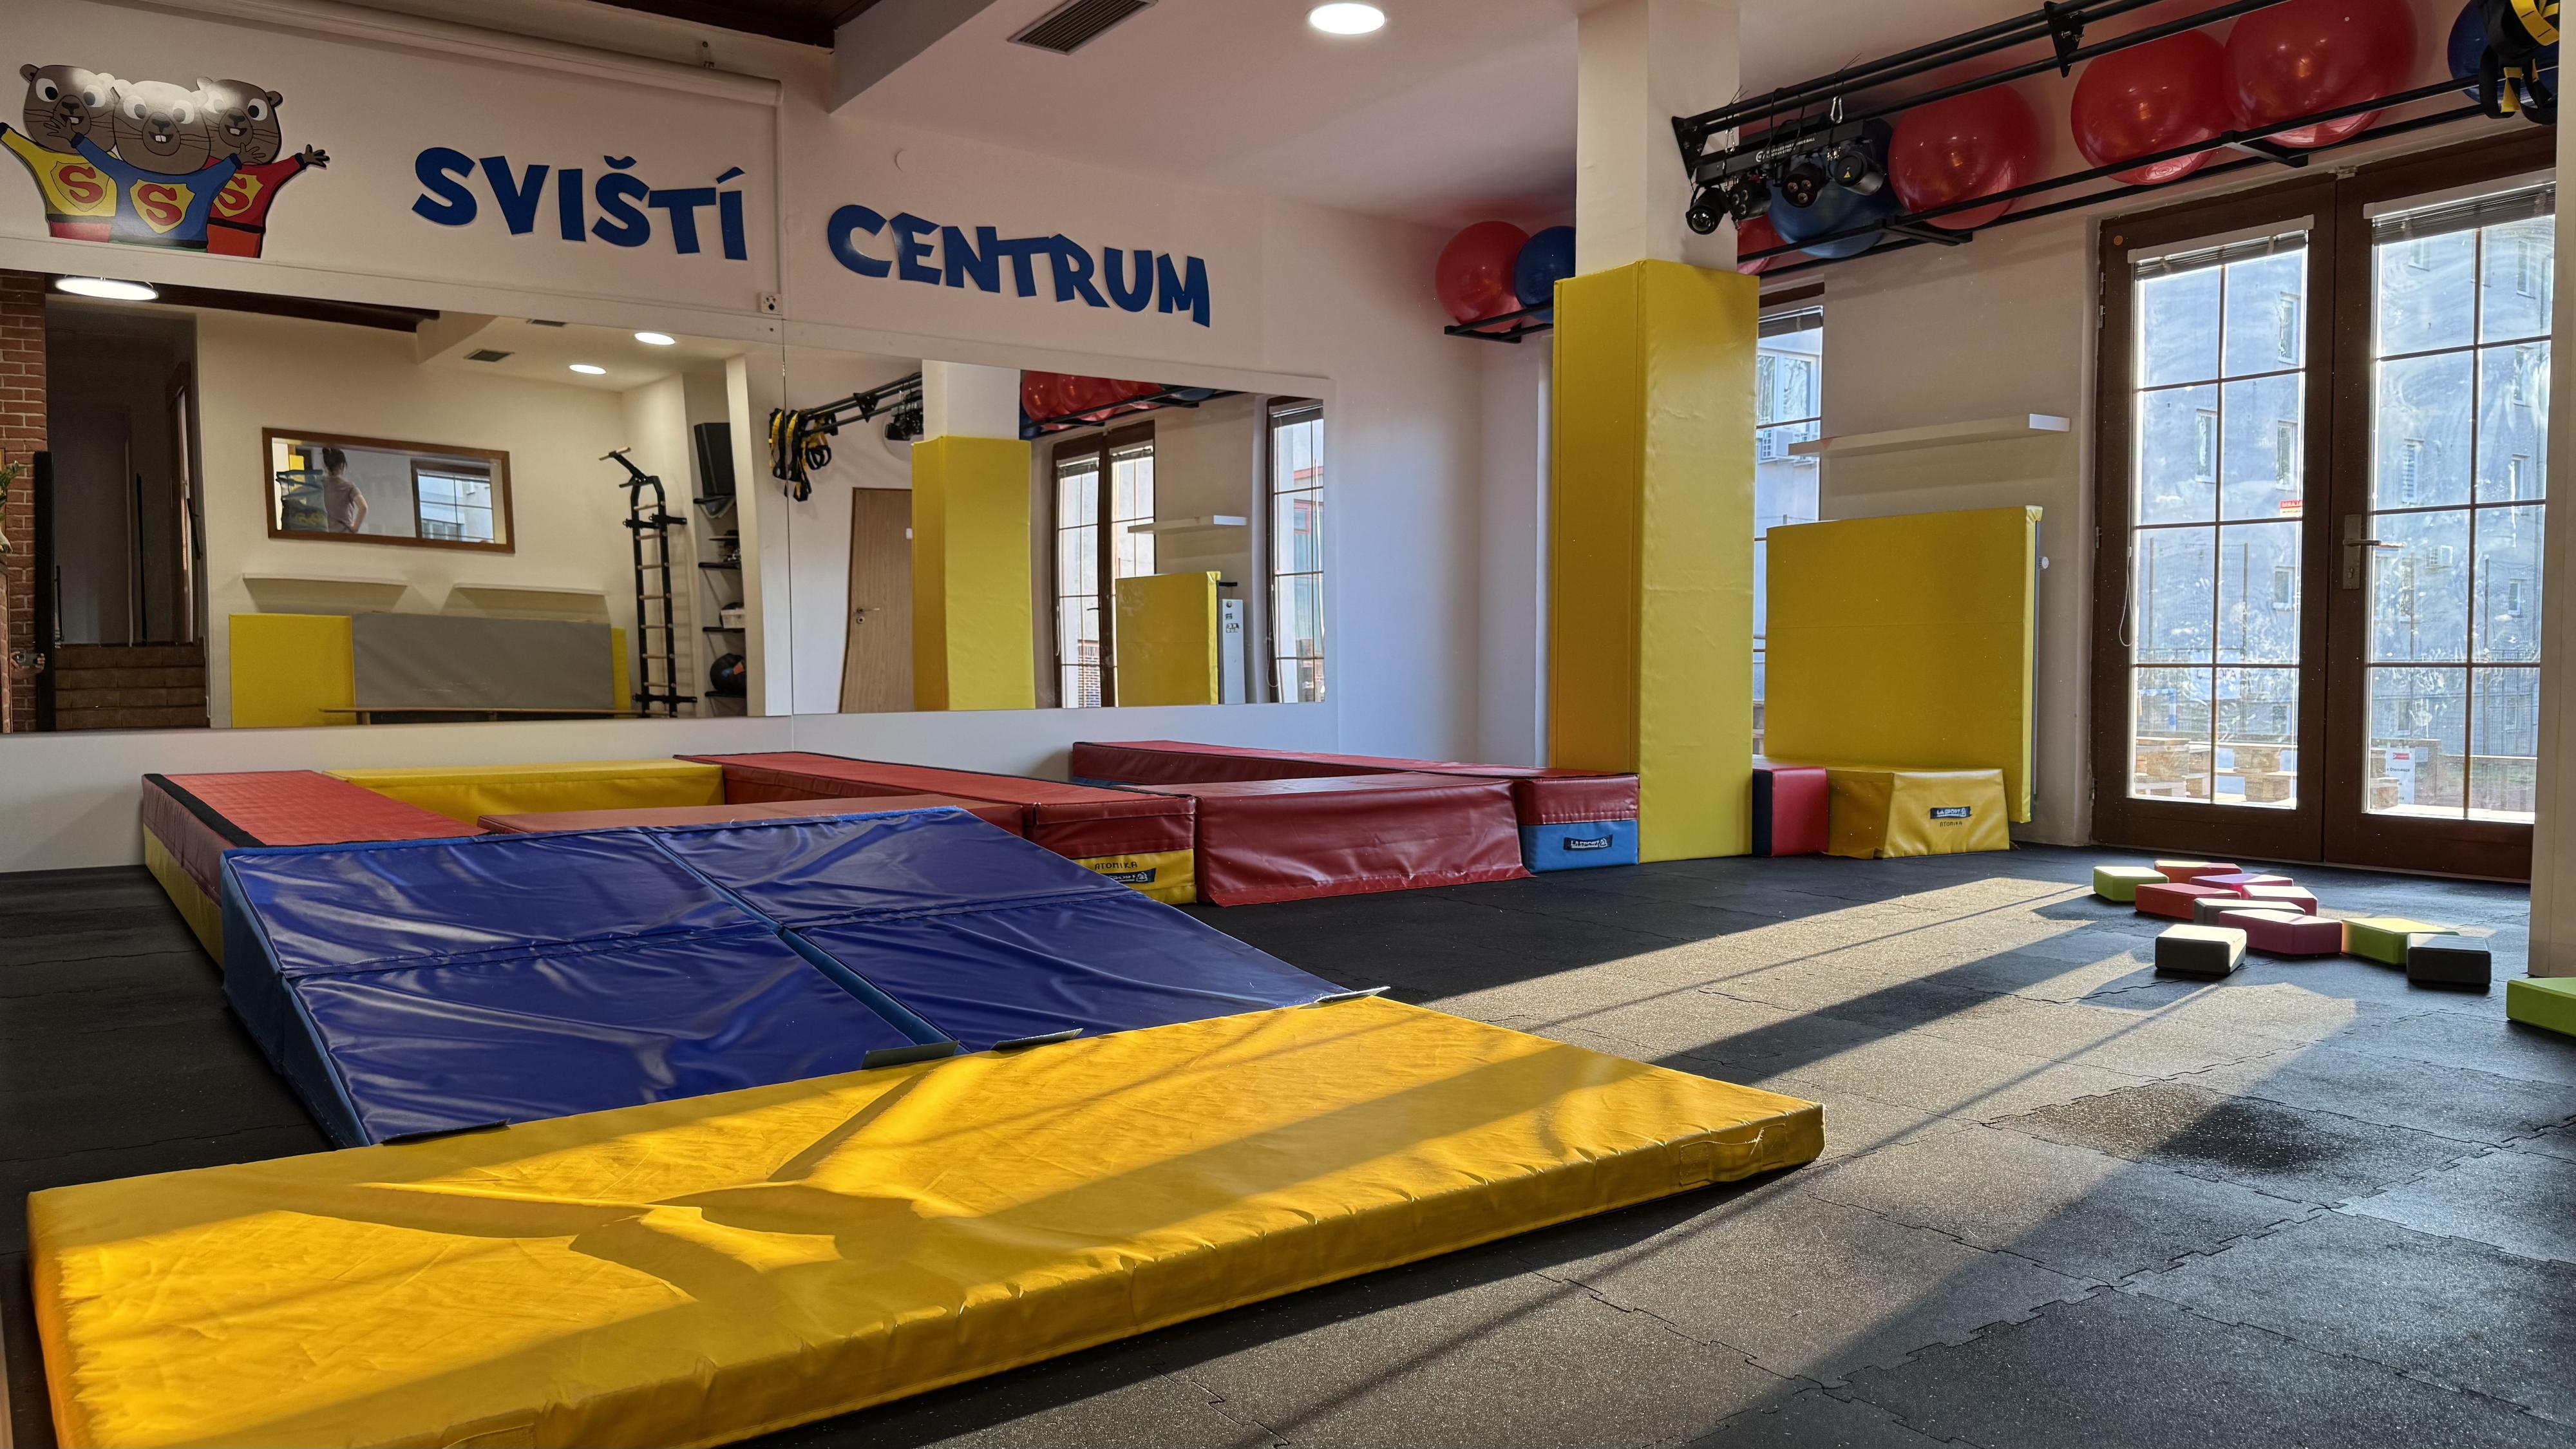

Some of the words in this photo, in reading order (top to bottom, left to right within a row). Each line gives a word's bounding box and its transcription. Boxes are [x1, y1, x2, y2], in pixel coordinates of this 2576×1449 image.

[59, 165, 104, 204] S
[137, 184, 183, 226] S
[412, 147, 748, 261] SVIŠTÍ
[827, 204, 1211, 328] CENTRUM
[1094, 861, 1138, 870] ATOMIKA
